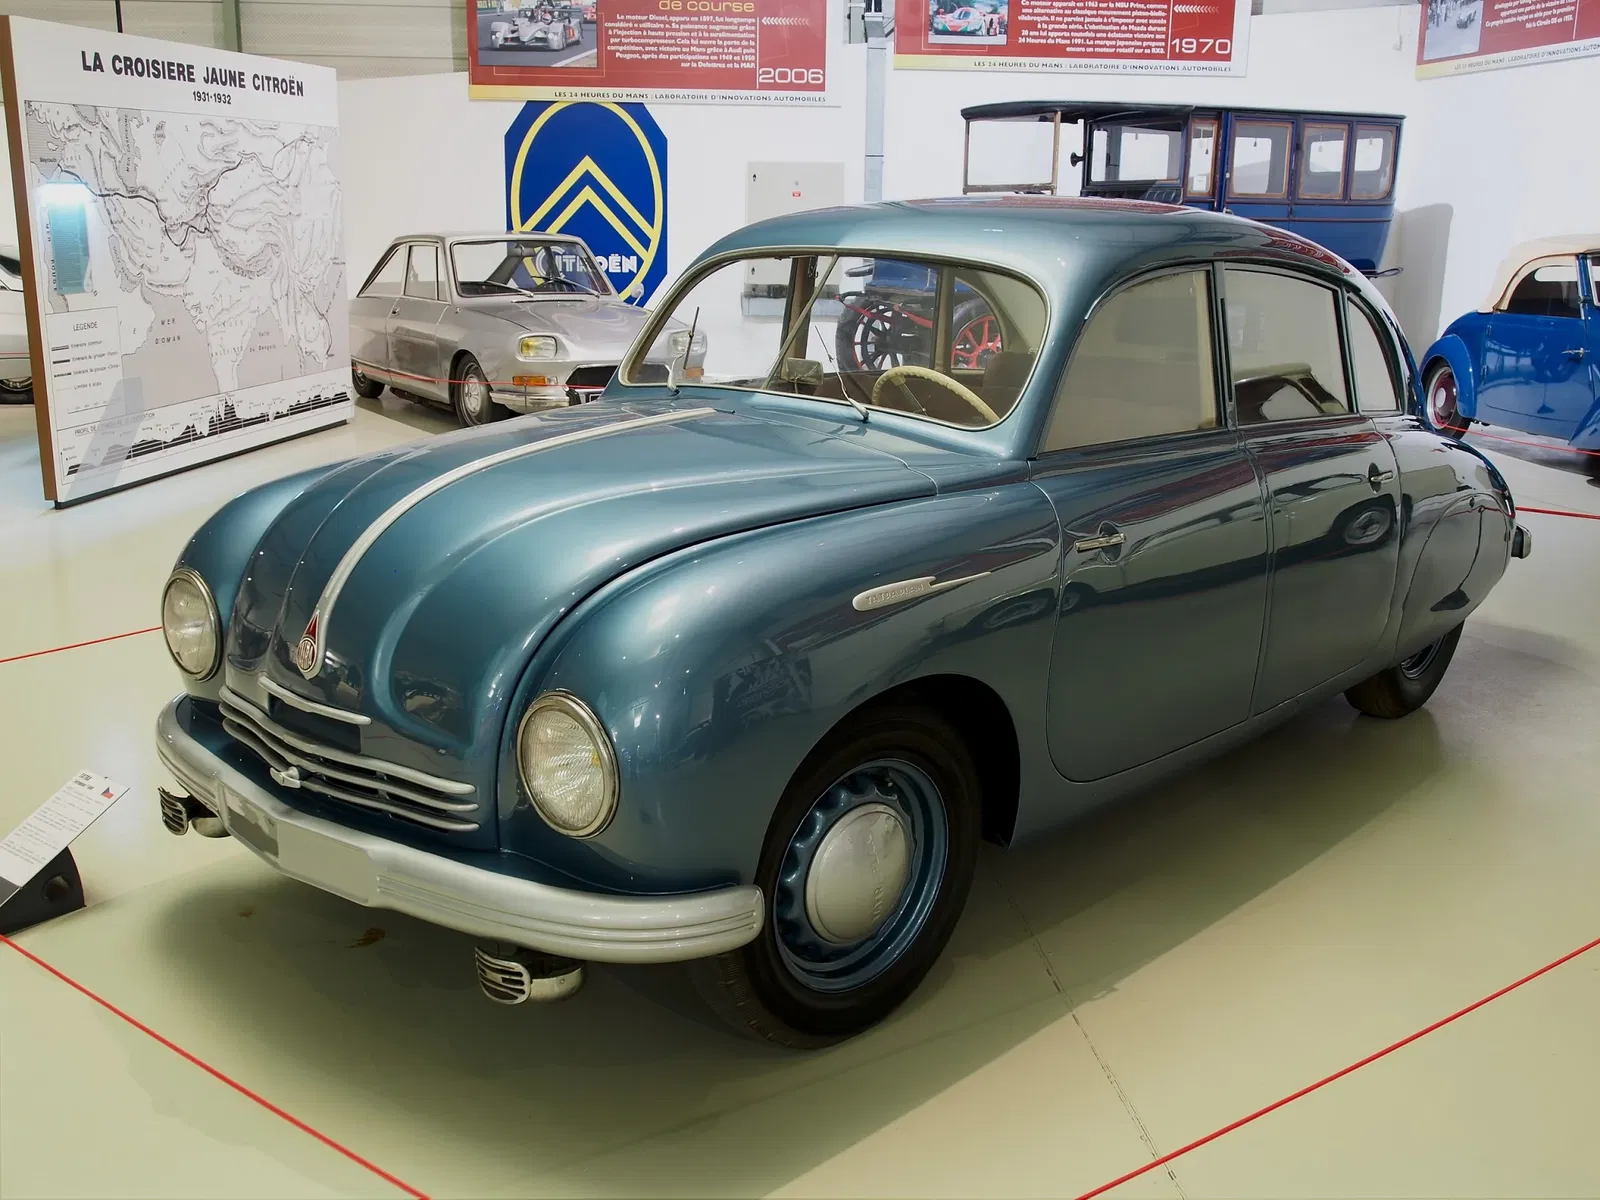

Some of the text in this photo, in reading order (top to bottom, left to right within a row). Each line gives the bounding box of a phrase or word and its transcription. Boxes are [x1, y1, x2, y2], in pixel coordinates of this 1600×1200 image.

[659, 0, 754, 12] de course
[1171, 38, 1231, 54] 1970
[82, 51, 304, 97] LA CROISIERE JAUNE CITROËN
[759, 68, 824, 84] 2006
[193, 91, 231, 105] 1931-1932
[73, 321, 98, 332] LEGENDE
